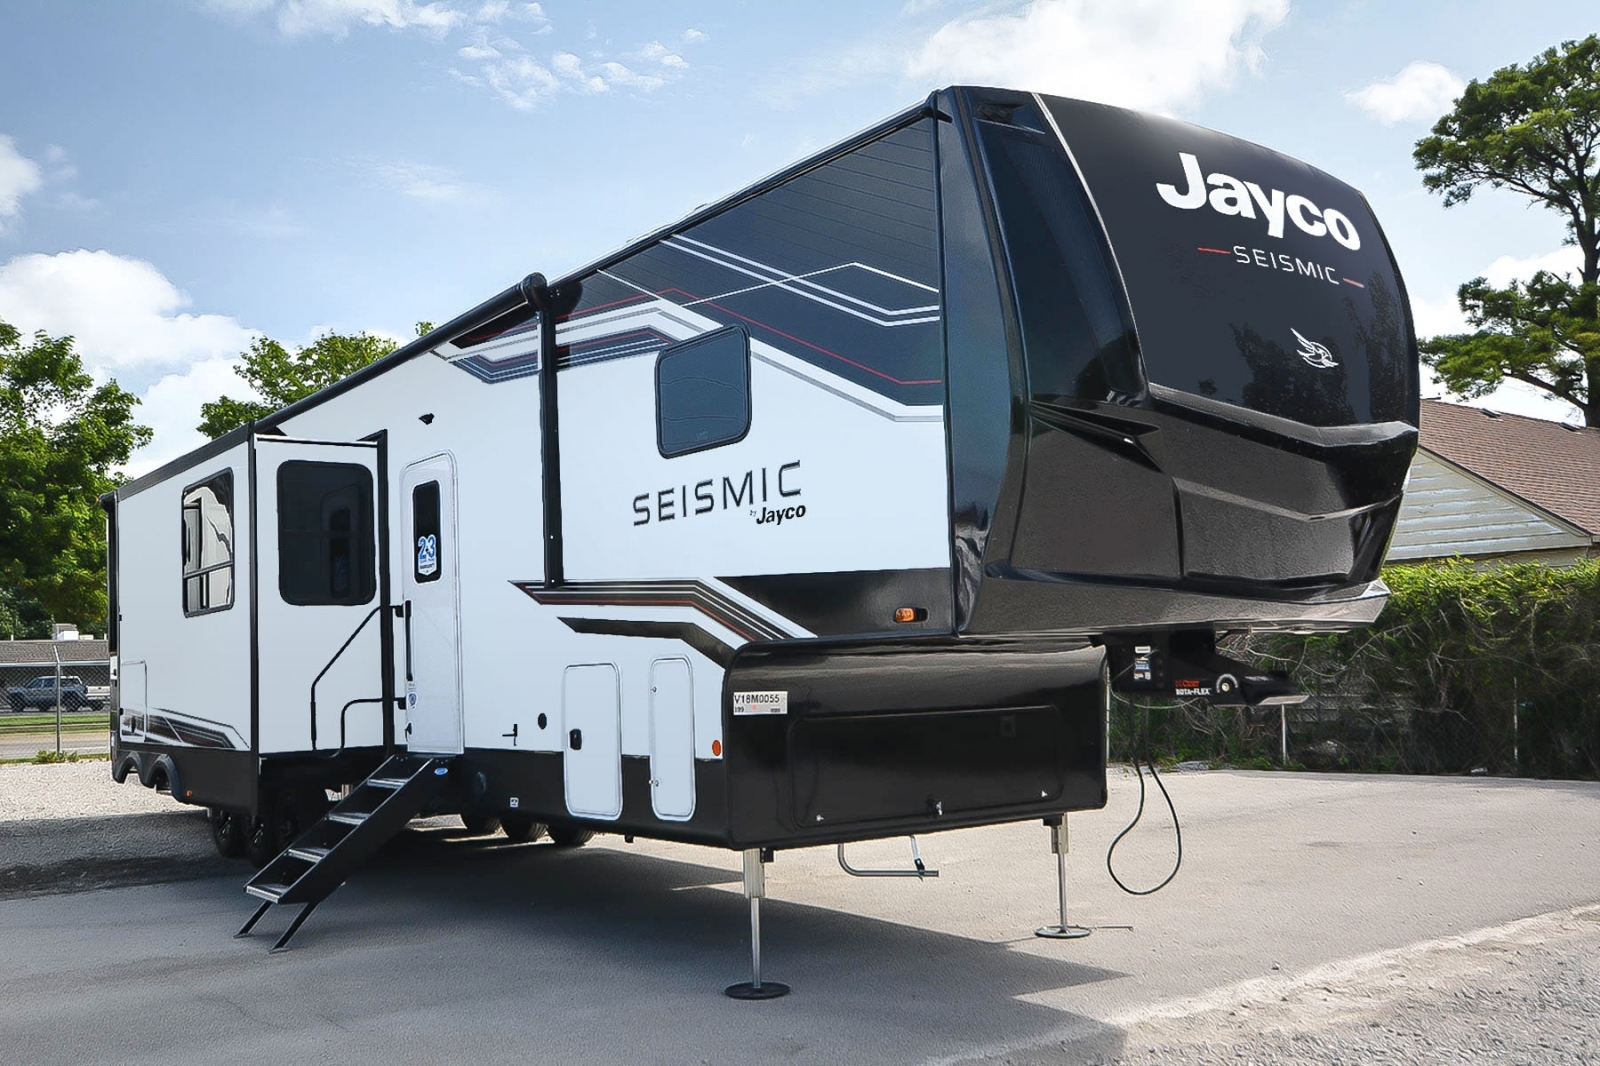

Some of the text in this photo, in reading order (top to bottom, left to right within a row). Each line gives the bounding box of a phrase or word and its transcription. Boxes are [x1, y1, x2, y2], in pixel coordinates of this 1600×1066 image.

[1155, 152, 1361, 251] Jayco
[1233, 245, 1340, 285] SEISMIC
[632, 459, 802, 526] SEISMIC
[756, 505, 806, 526] Jayco
[734, 693, 780, 704] V18M0055
